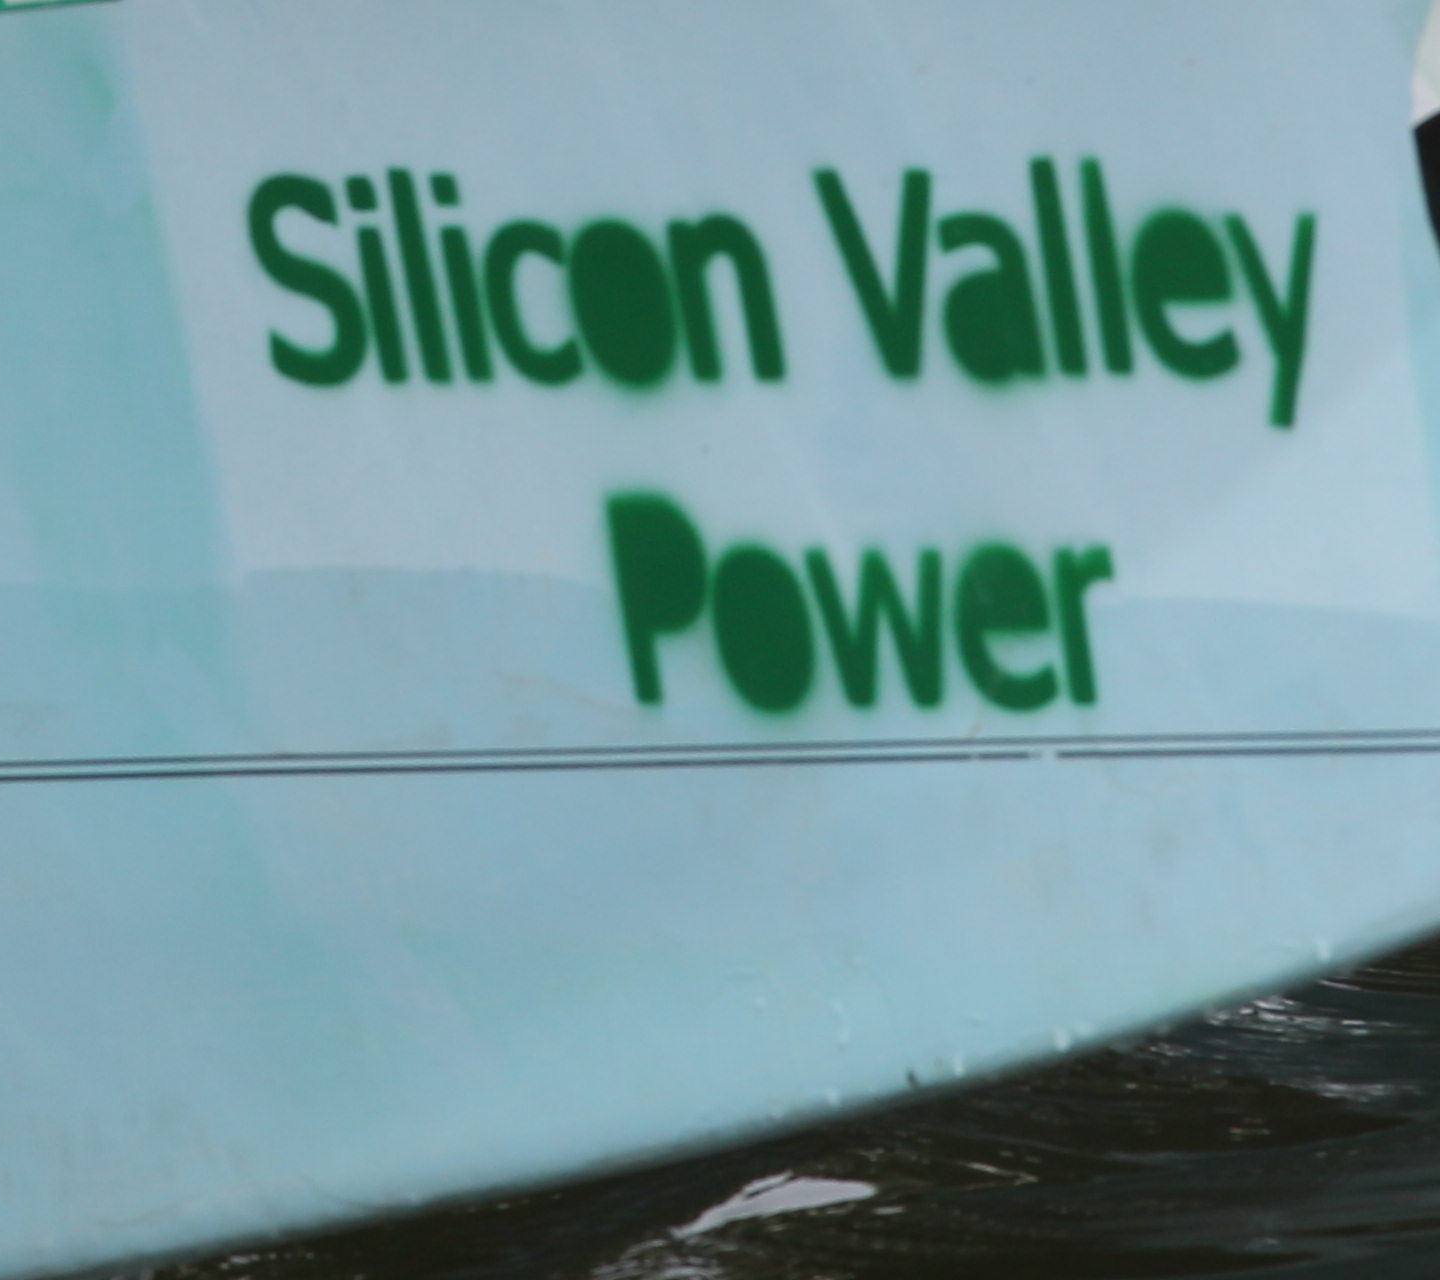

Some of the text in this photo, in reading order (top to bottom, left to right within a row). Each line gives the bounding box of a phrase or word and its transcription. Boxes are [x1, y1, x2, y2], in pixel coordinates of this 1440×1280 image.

[245, 154, 1317, 431] Silicon Valley
[603, 490, 1116, 716] Power
